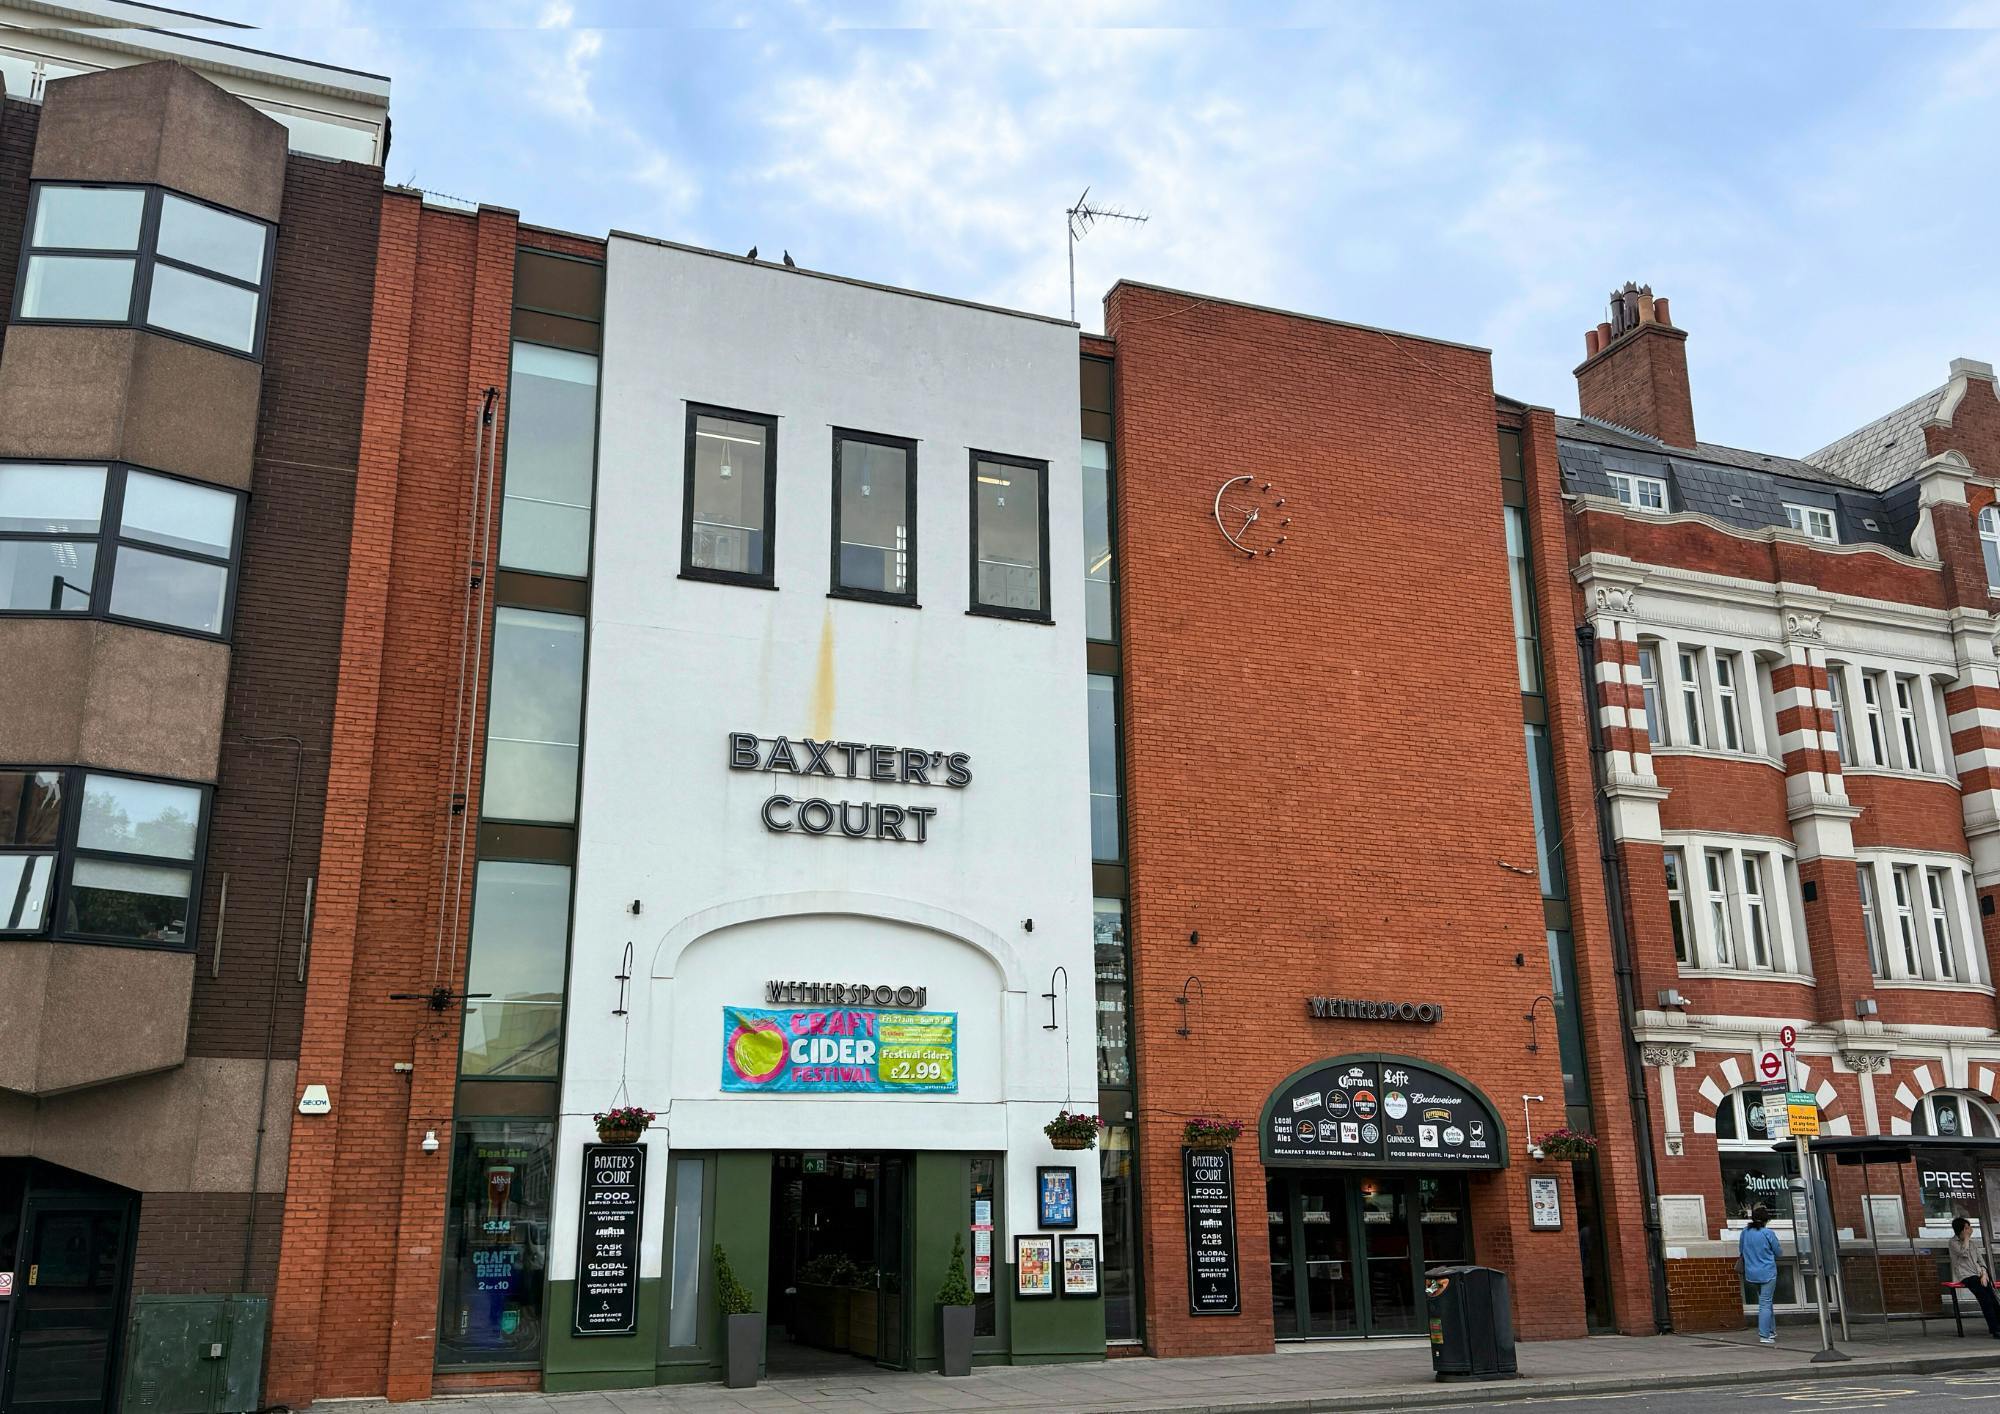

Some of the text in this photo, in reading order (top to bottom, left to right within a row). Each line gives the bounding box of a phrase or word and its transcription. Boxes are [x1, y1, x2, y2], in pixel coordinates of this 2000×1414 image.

[729, 732, 972, 788] BAXTER'S
[762, 794, 937, 842] COURT
[768, 980, 926, 1008] WETHERSPOON
[1311, 996, 1443, 1022] WETHERSPOON
[790, 1011, 876, 1036] CRAFT
[1784, 1030, 1792, 1043] B
[790, 1038, 876, 1064] CIDER
[882, 1050, 950, 1060] Festival ciders
[790, 1066, 876, 1083] FESTIVAL
[890, 1062, 941, 1080] £2.99
[1338, 1074, 1374, 1089] Corona
[1384, 1069, 1408, 1087] Leffe
[1410, 1092, 1462, 1104] Budweiser
[1386, 1134, 1415, 1144] GUINNESS
[479, 1148, 528, 1158] Real Ale
[594, 1156, 635, 1169] BAXTER'S
[1192, 1156, 1223, 1167] BAXTER'S
[491, 1175, 511, 1184] Abbot
[596, 1171, 631, 1184] COURT
[1195, 1169, 1221, 1180] COURT
[472, 1250, 519, 1264] CRAFT
[477, 1264, 512, 1277] BEER
[478, 1281, 485, 1290] 2
[494, 1281, 509, 1290] £10
